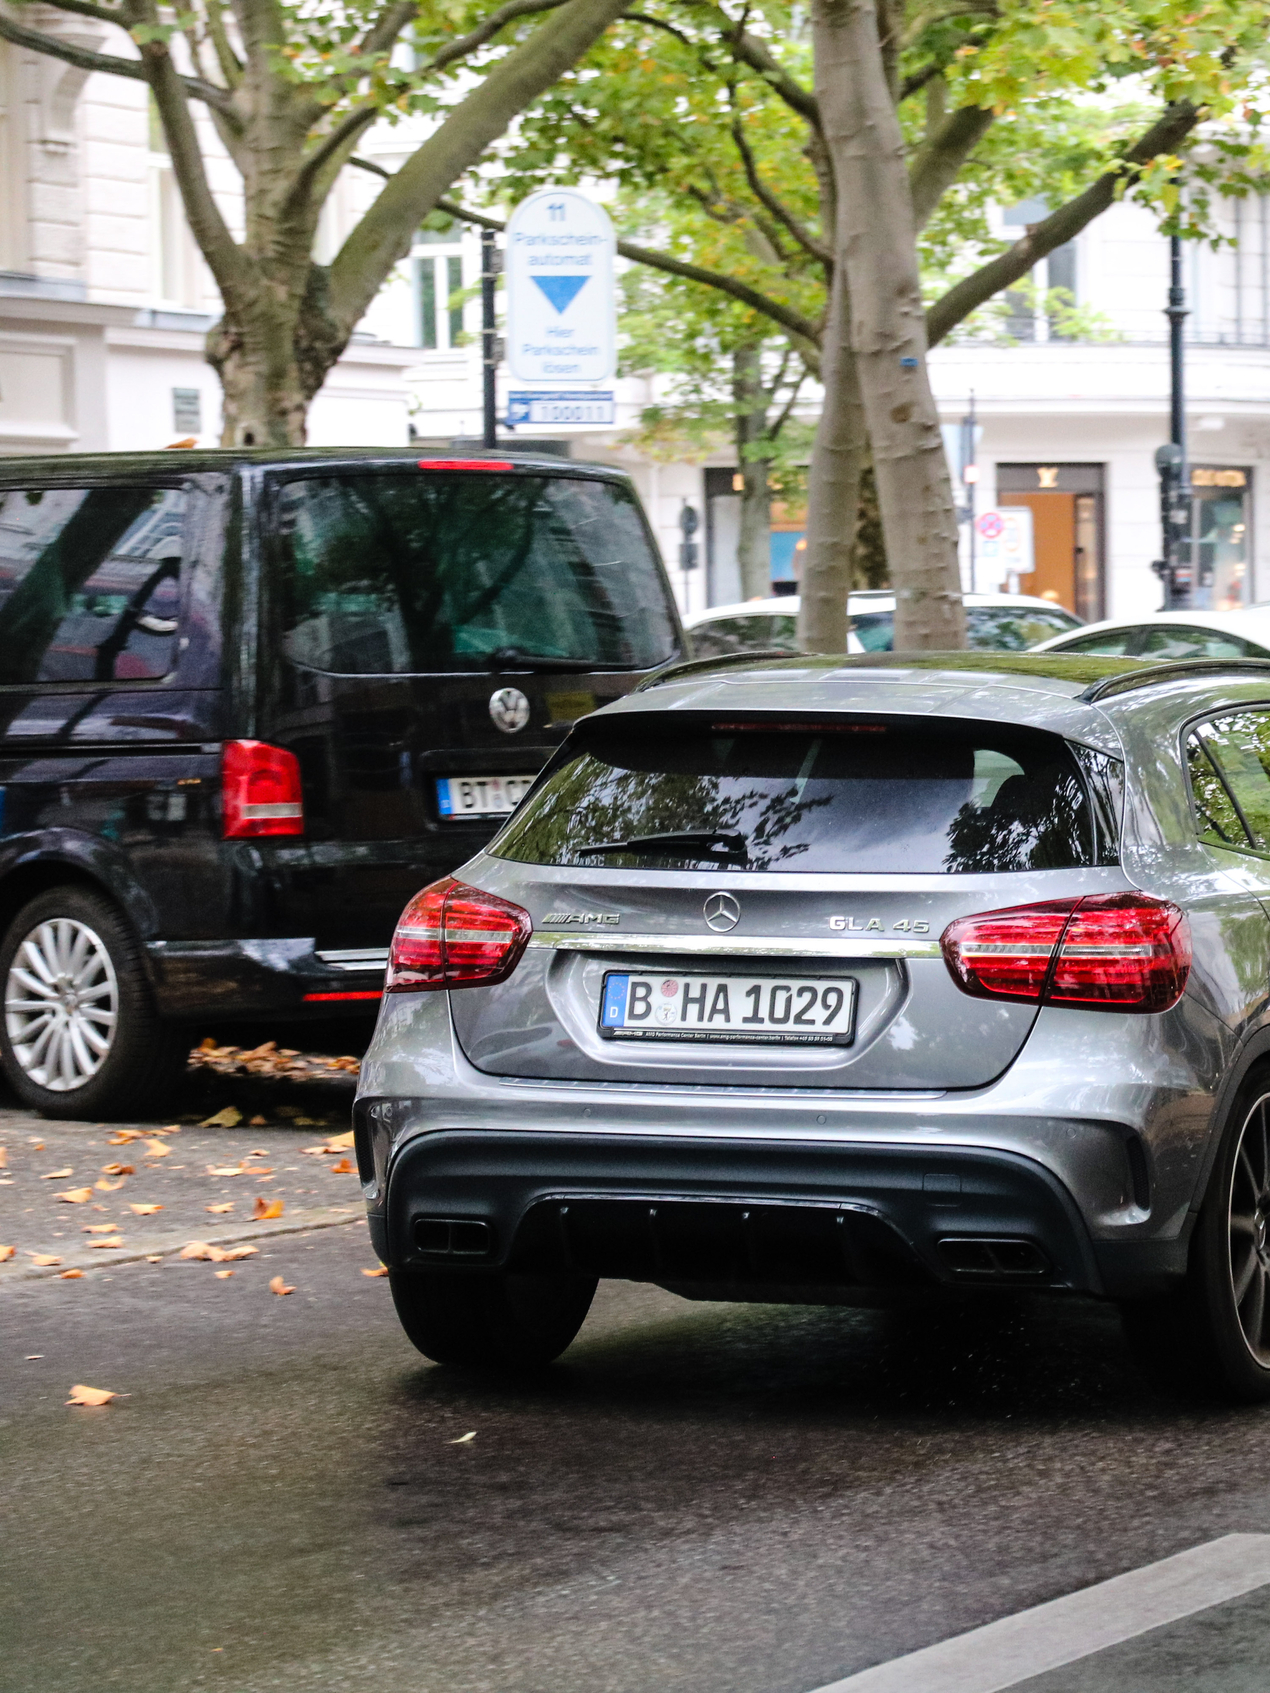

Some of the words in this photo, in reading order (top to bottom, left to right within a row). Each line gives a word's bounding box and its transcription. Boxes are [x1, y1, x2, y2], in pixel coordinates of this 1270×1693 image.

[547, 203, 566, 222] 11
[528, 253, 593, 266] automat
[545, 326, 575, 338] Hier
[522, 343, 598, 356] Parkschein
[461, 782, 488, 808] BT
[566, 913, 620, 925] AMG
[829, 915, 885, 932] GLA
[892, 918, 930, 933] 45
[627, 981, 653, 1020] B
[680, 982, 731, 1023] HA
[741, 984, 844, 1026] 1029
[610, 1006, 619, 1018] D
